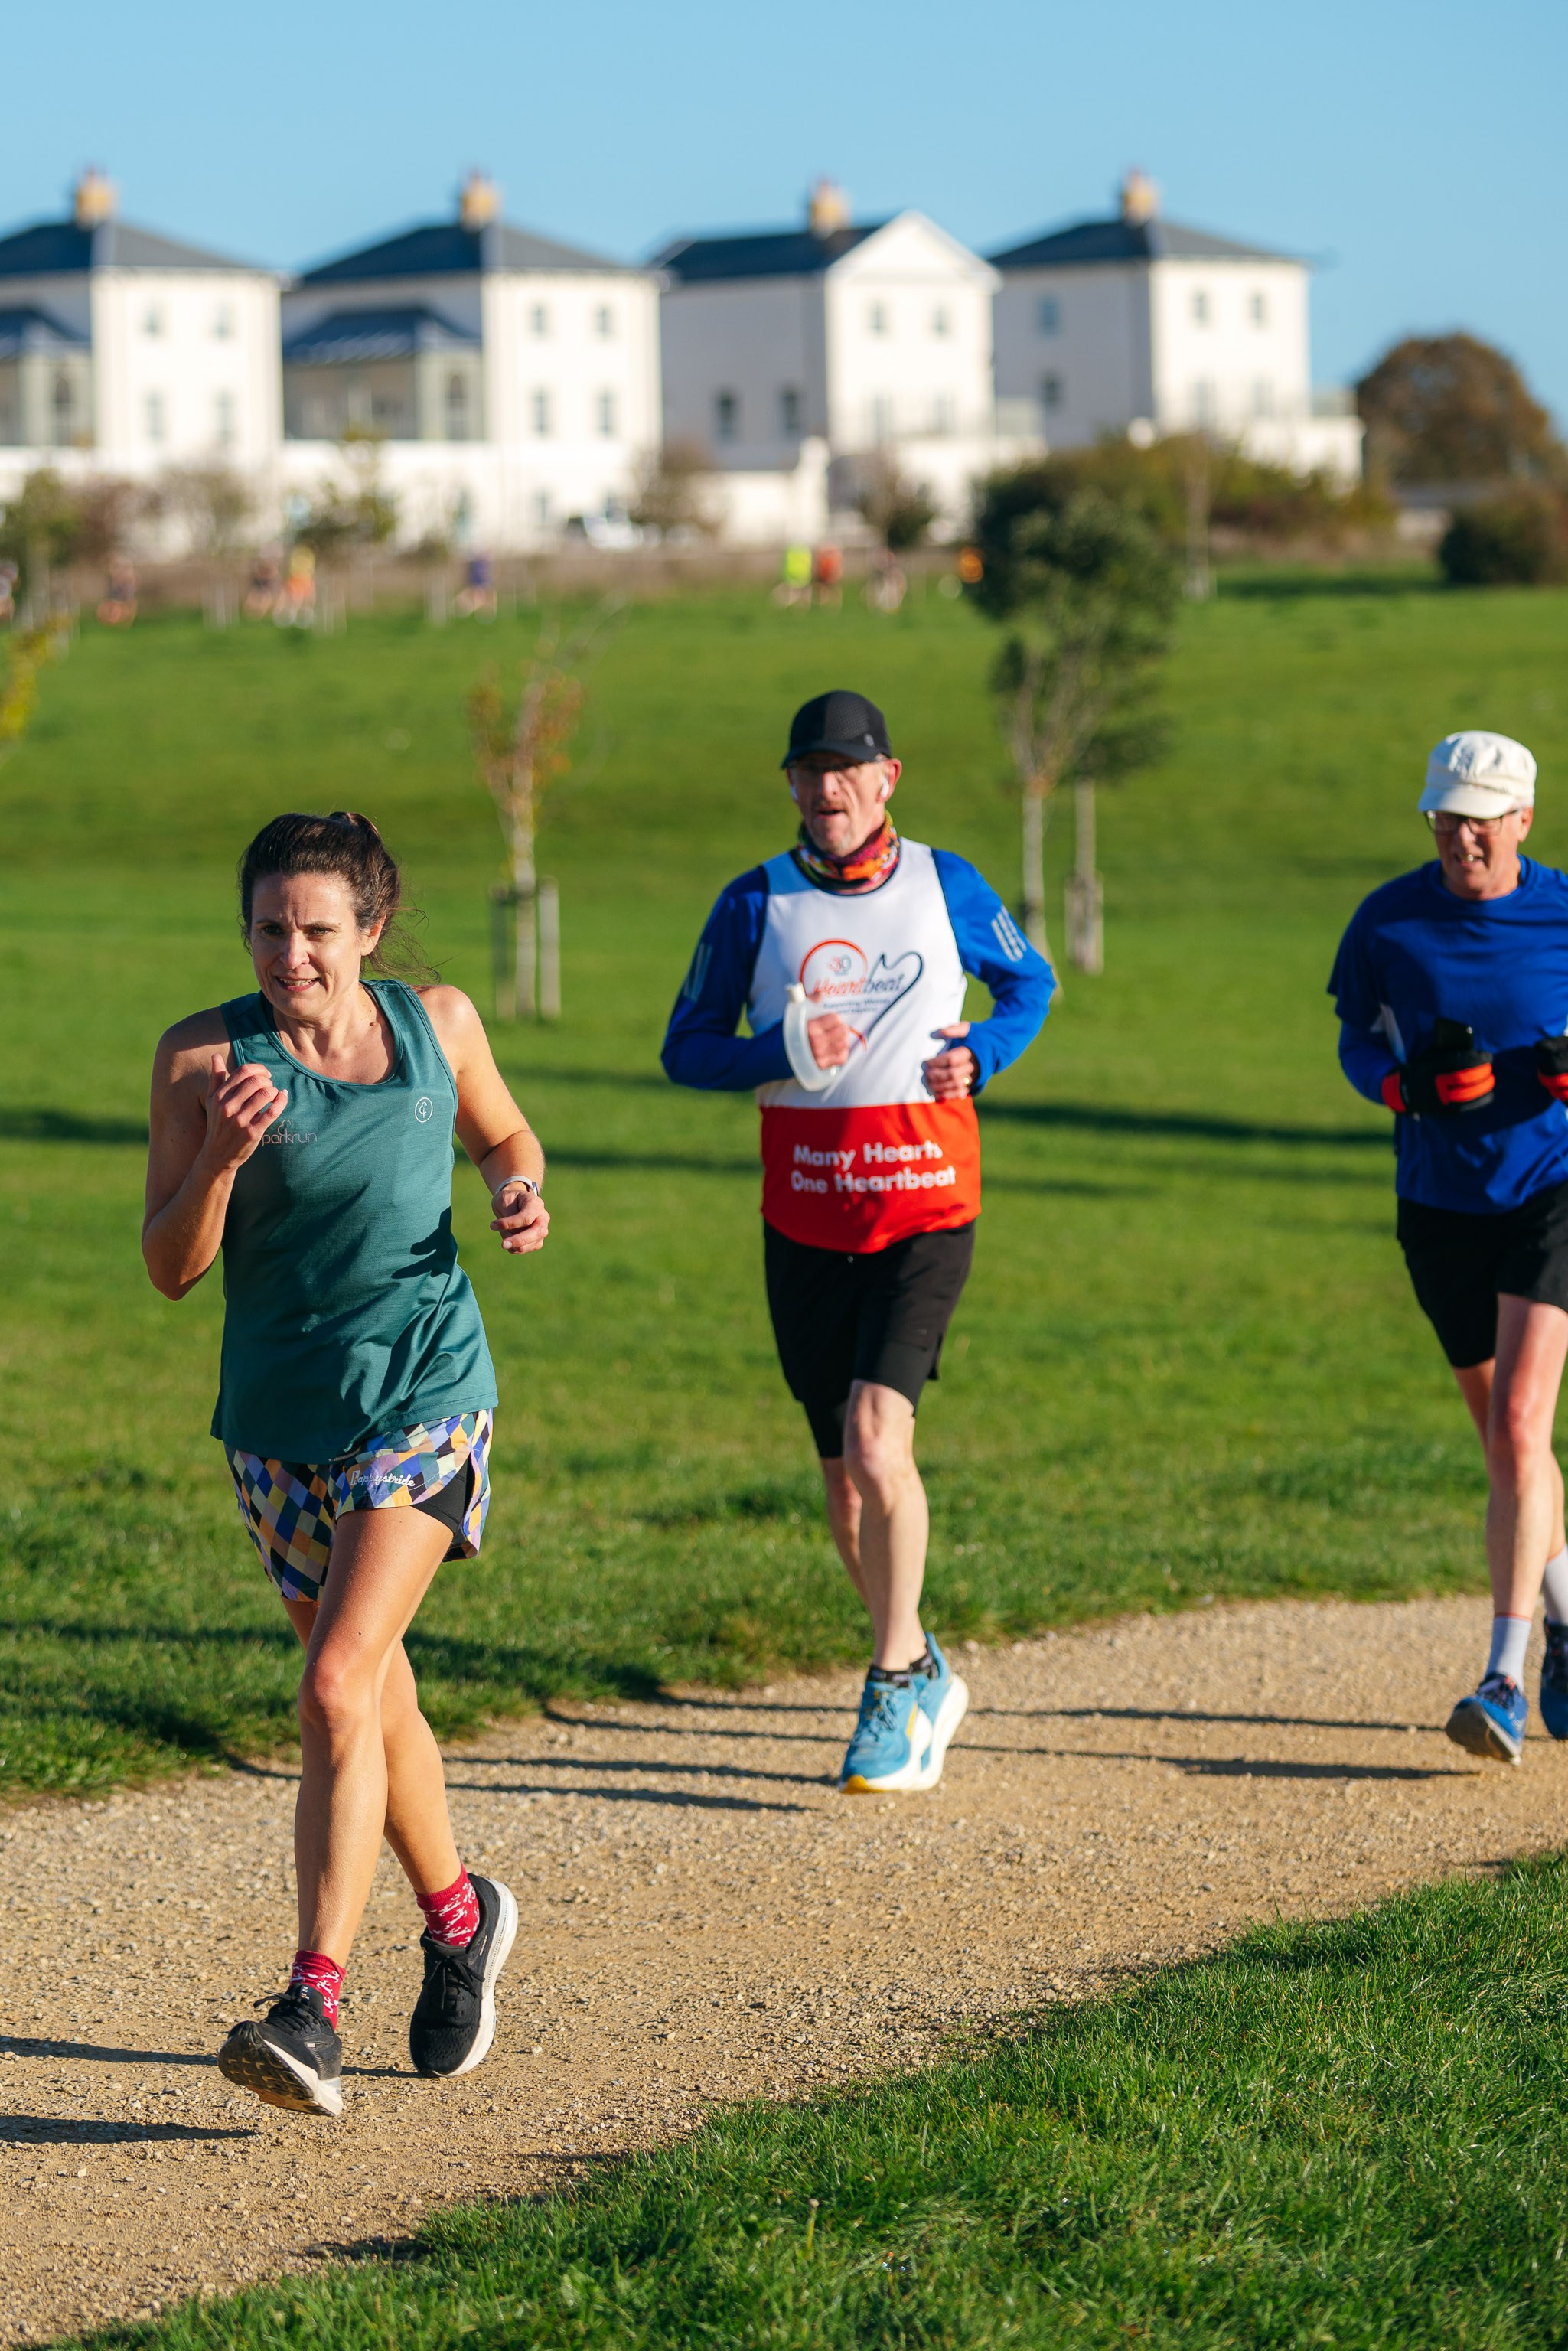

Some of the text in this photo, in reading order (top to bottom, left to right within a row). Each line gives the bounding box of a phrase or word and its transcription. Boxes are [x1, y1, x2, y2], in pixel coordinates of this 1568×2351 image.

[812, 974, 905, 996] Heartbeat
[262, 1125, 318, 1146] parkrun
[793, 1141, 944, 1172] Many Hearts
[791, 1166, 956, 1194] One Heartbeat
